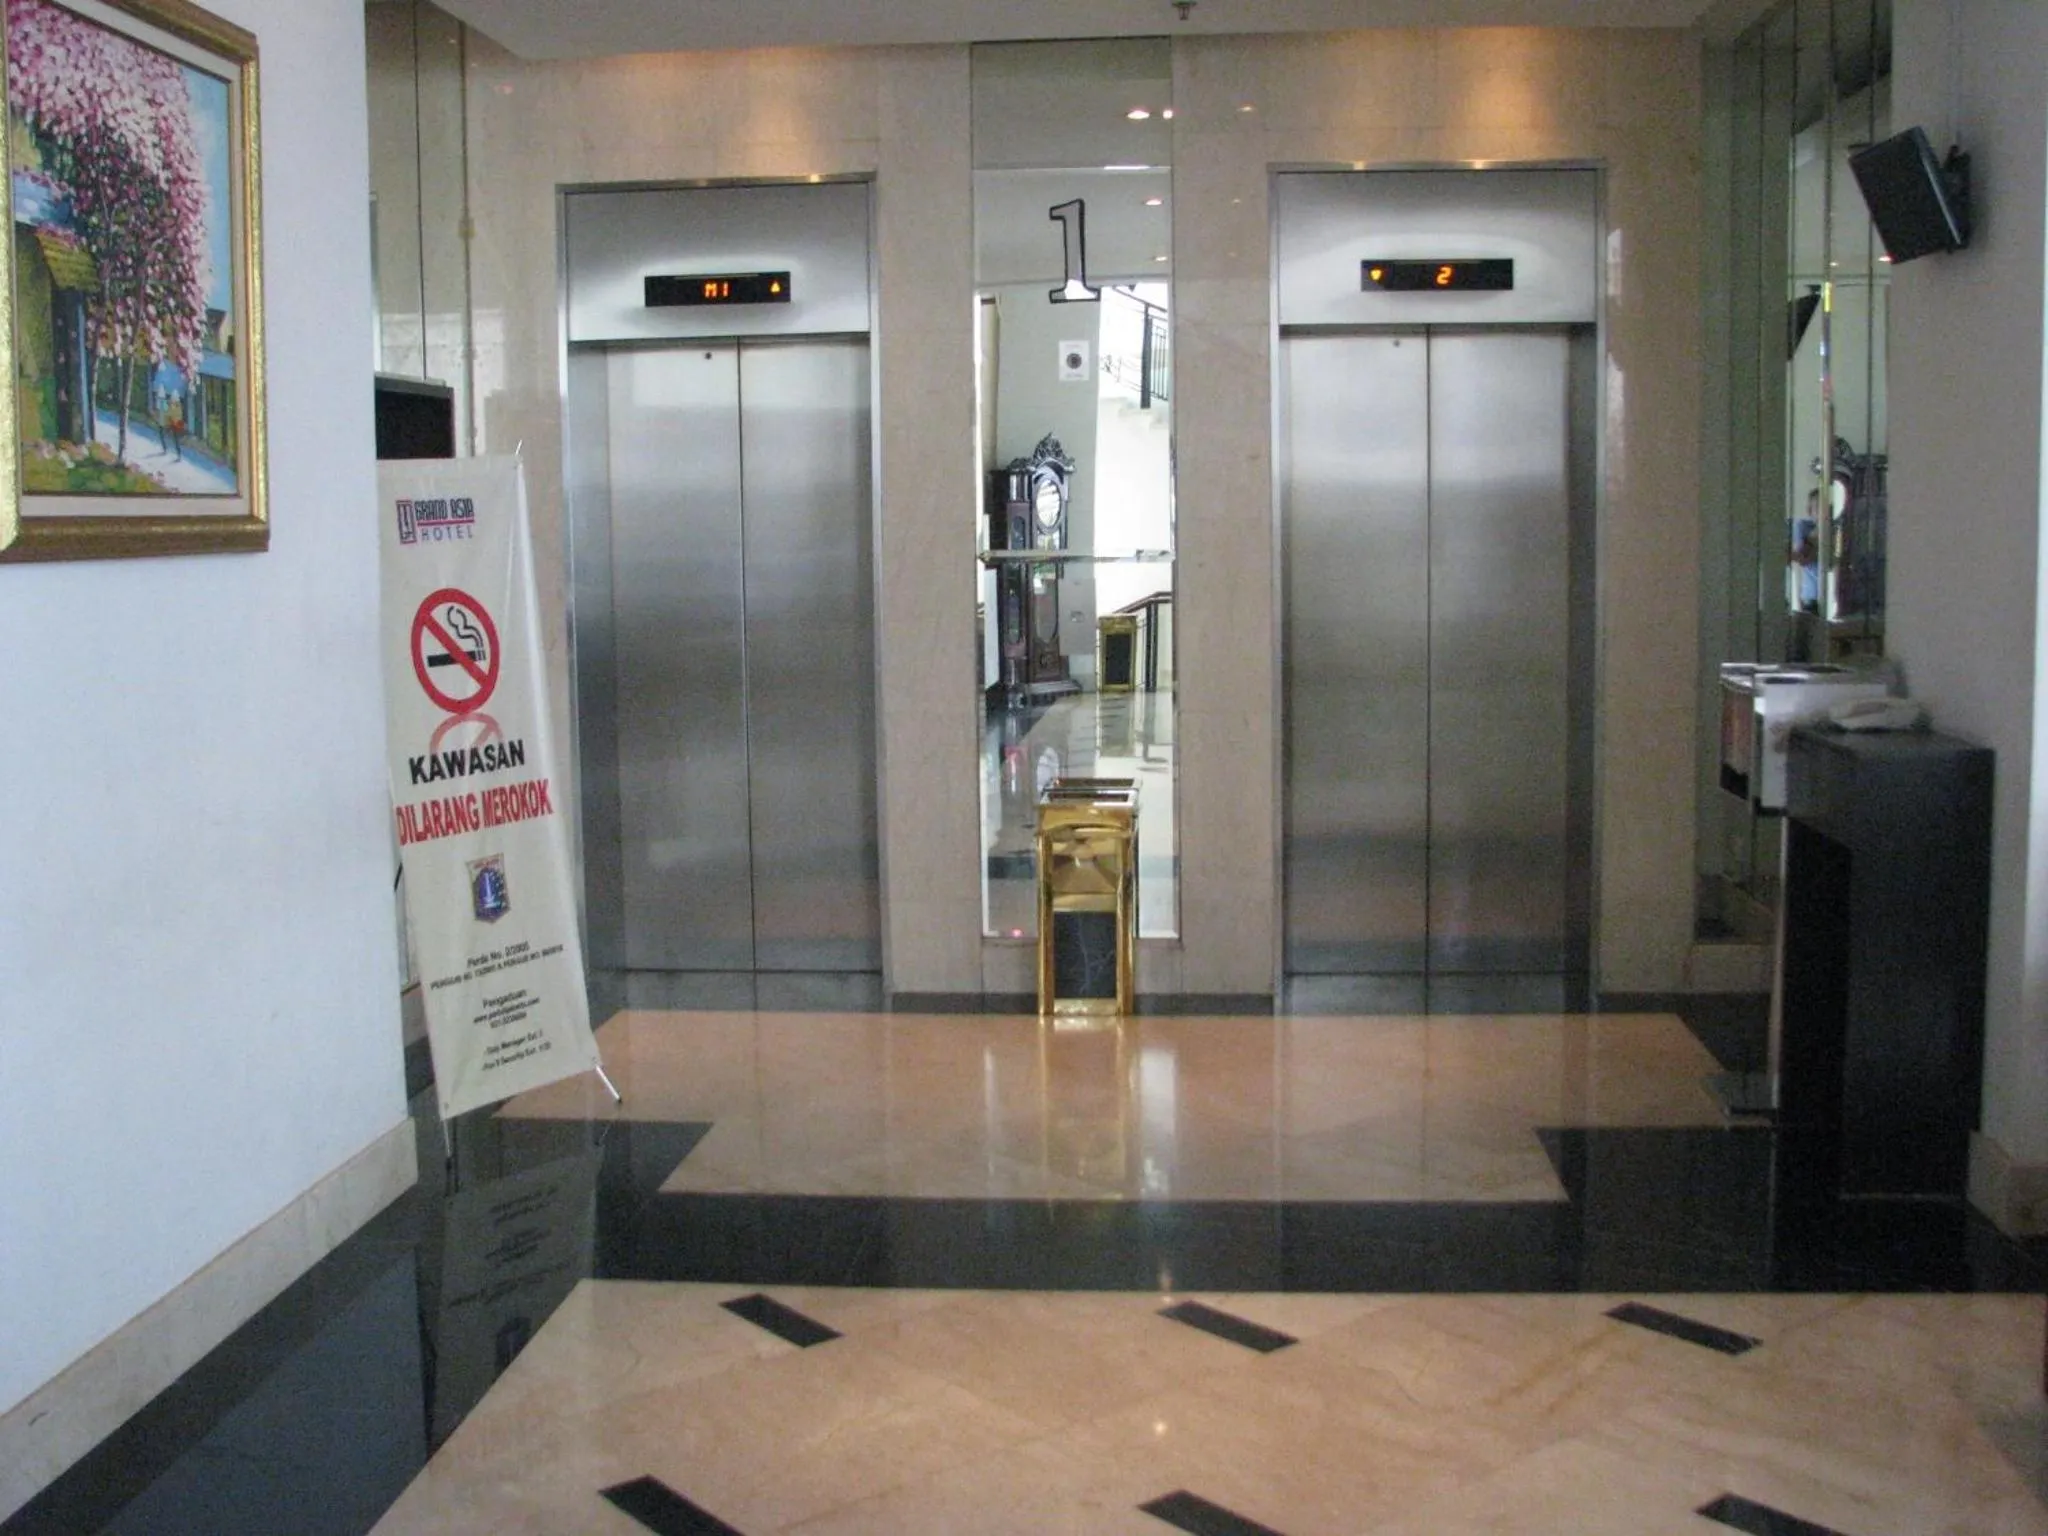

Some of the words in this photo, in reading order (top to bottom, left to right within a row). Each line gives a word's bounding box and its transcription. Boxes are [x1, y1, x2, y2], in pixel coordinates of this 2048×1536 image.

[1049, 198, 1101, 304] 1
[1436, 266, 1452, 285] 2
[421, 525, 473, 541] HOTEL
[408, 738, 525, 785] KAWASAN
[395, 793, 480, 846] DILARANG
[481, 778, 554, 828] MEROKOK
